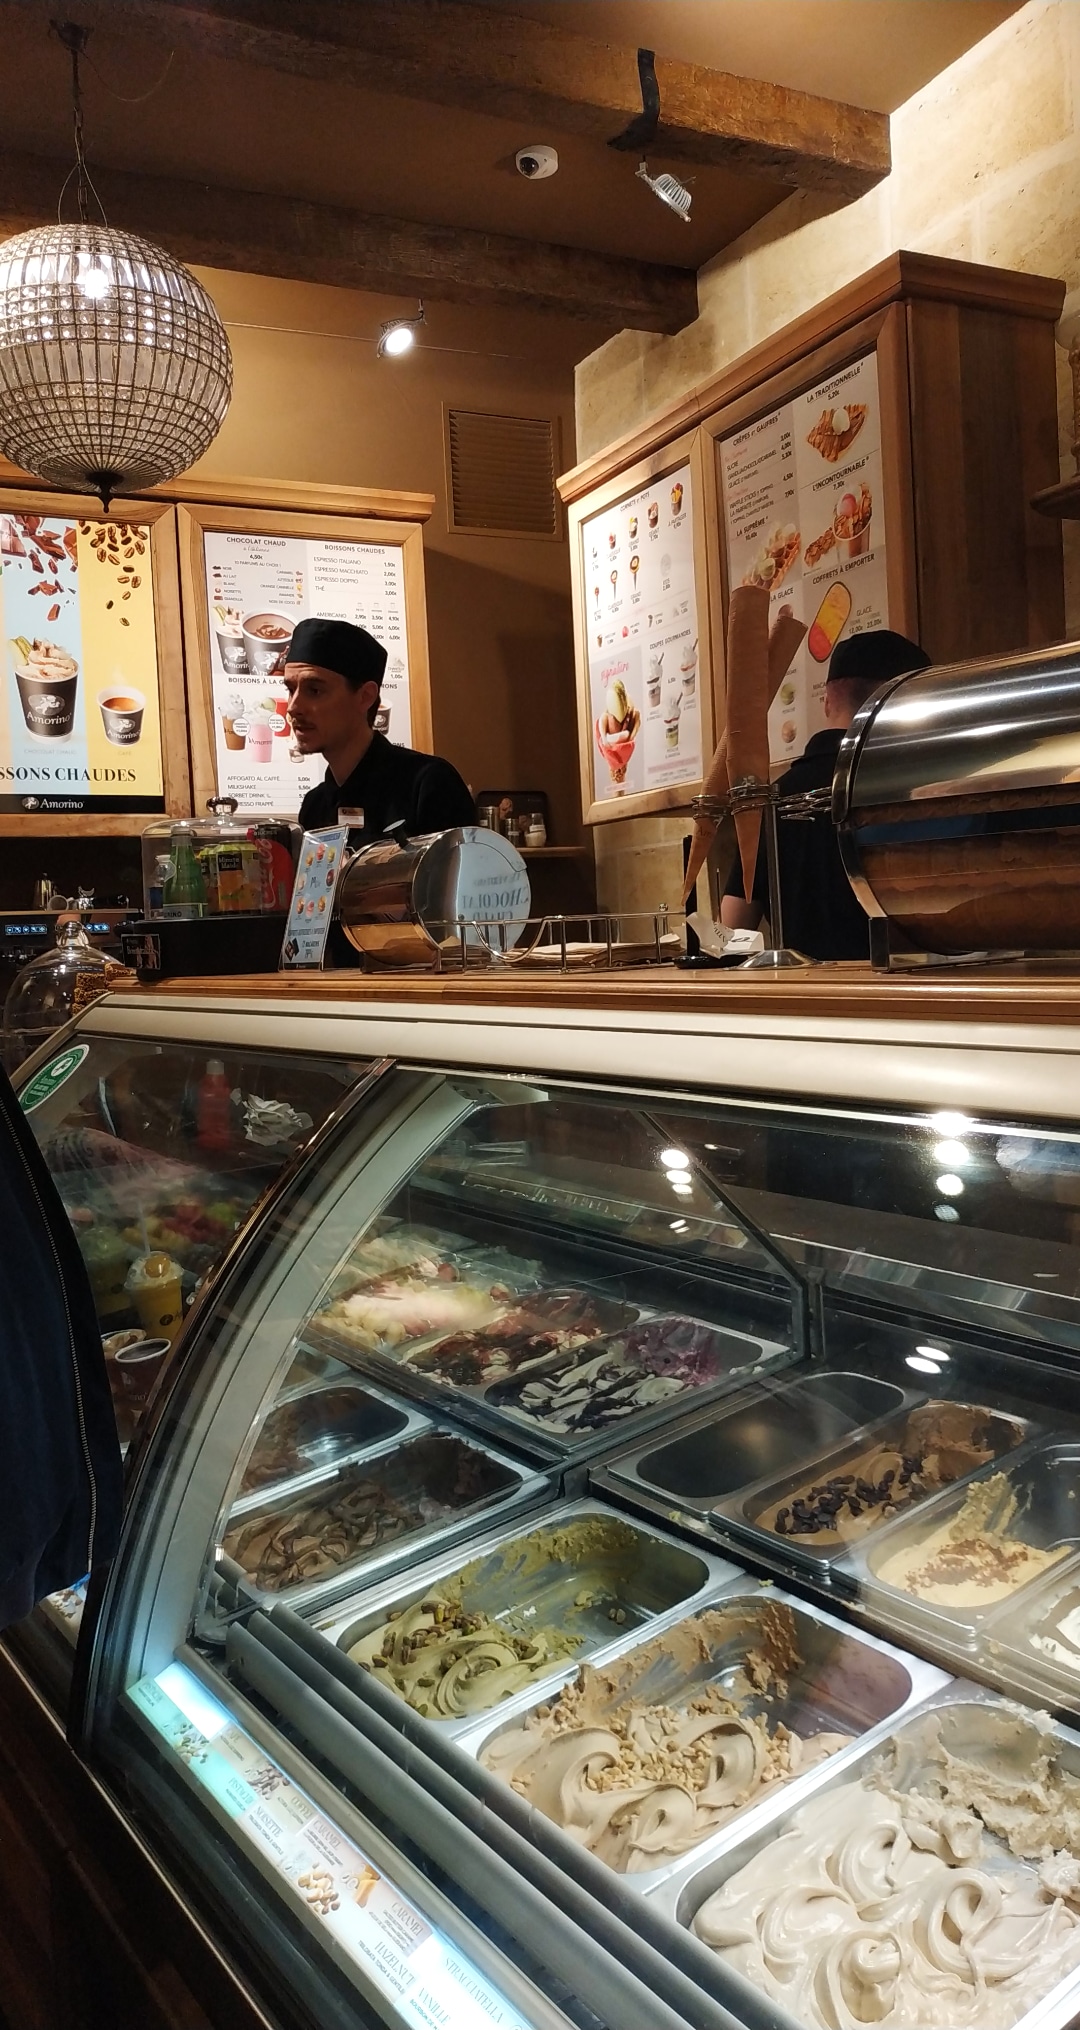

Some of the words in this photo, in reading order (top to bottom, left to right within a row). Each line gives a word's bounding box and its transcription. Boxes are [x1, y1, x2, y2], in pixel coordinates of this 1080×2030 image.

[806, 394, 814, 403] LA
[814, 365, 861, 398] TRADITIONNELLE
[756, 415, 778, 433] GAUFRES
[812, 458, 866, 492] L'INCONTOURNABLE
[736, 529, 743, 537] LA
[743, 517, 766, 534] SUPRÊME
[226, 536, 261, 545] CHOCOLAT
[263, 539, 287, 547] CHAUD
[324, 544, 355, 552] BOISSONS
[356, 547, 386, 555] CHAUDES
[313, 556, 338, 564] ESPRESSO
[338, 558, 361, 566] ITALIANO
[812, 568, 839, 585] COFFRETS
[844, 553, 875, 572] EMPORTER
[339, 568, 368, 576] MACCHIATO
[777, 587, 794, 600] GLACE
[856, 605, 872, 617] GLACE
[27, 711, 69, 725] Amorino
[107, 729, 139, 740] Amorino
[55, 767, 137, 782] CHAUDES
[40, 798, 84, 809] Amorino
[254, 1805, 284, 1838] NOISETTE
[313, 1820, 342, 1851] CARAMEL
[358, 1939, 375, 1961] TRILOBATA
[375, 1956, 387, 1974] TONDA
[373, 1941, 417, 1986] HAZELNUT
[444, 1956, 505, 2024] STRACCIATELLA
[417, 1987, 451, 2025] VANILLE
